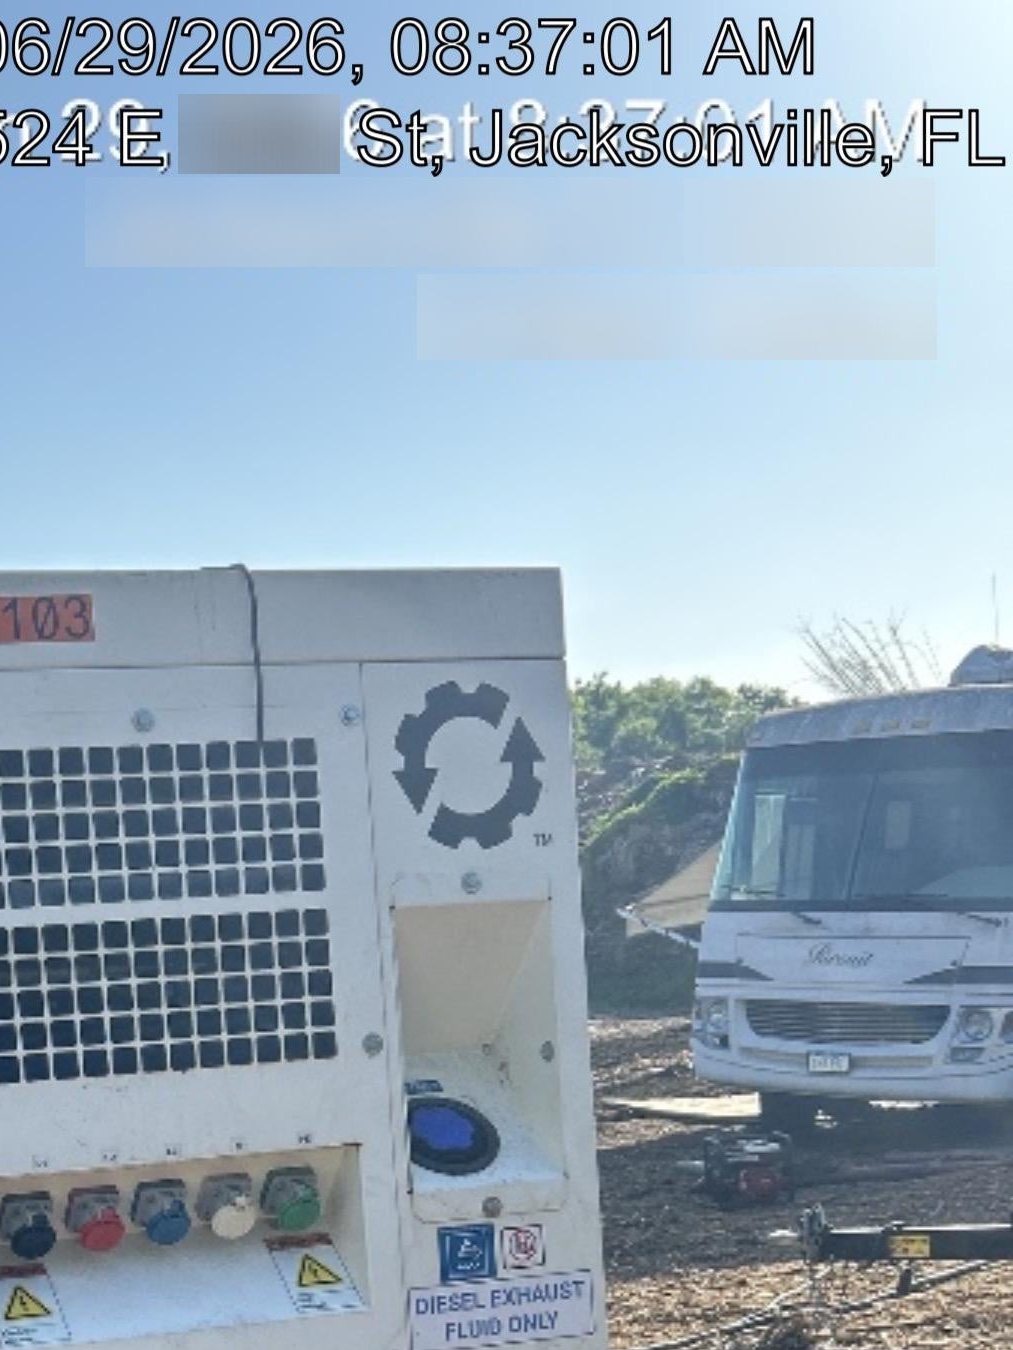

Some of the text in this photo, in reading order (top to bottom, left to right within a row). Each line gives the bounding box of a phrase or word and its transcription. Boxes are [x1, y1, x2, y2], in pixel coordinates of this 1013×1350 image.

[415, 1281, 585, 1315] DIESEL EXHAUST
[445, 1311, 558, 1342] FLUID ONLY
